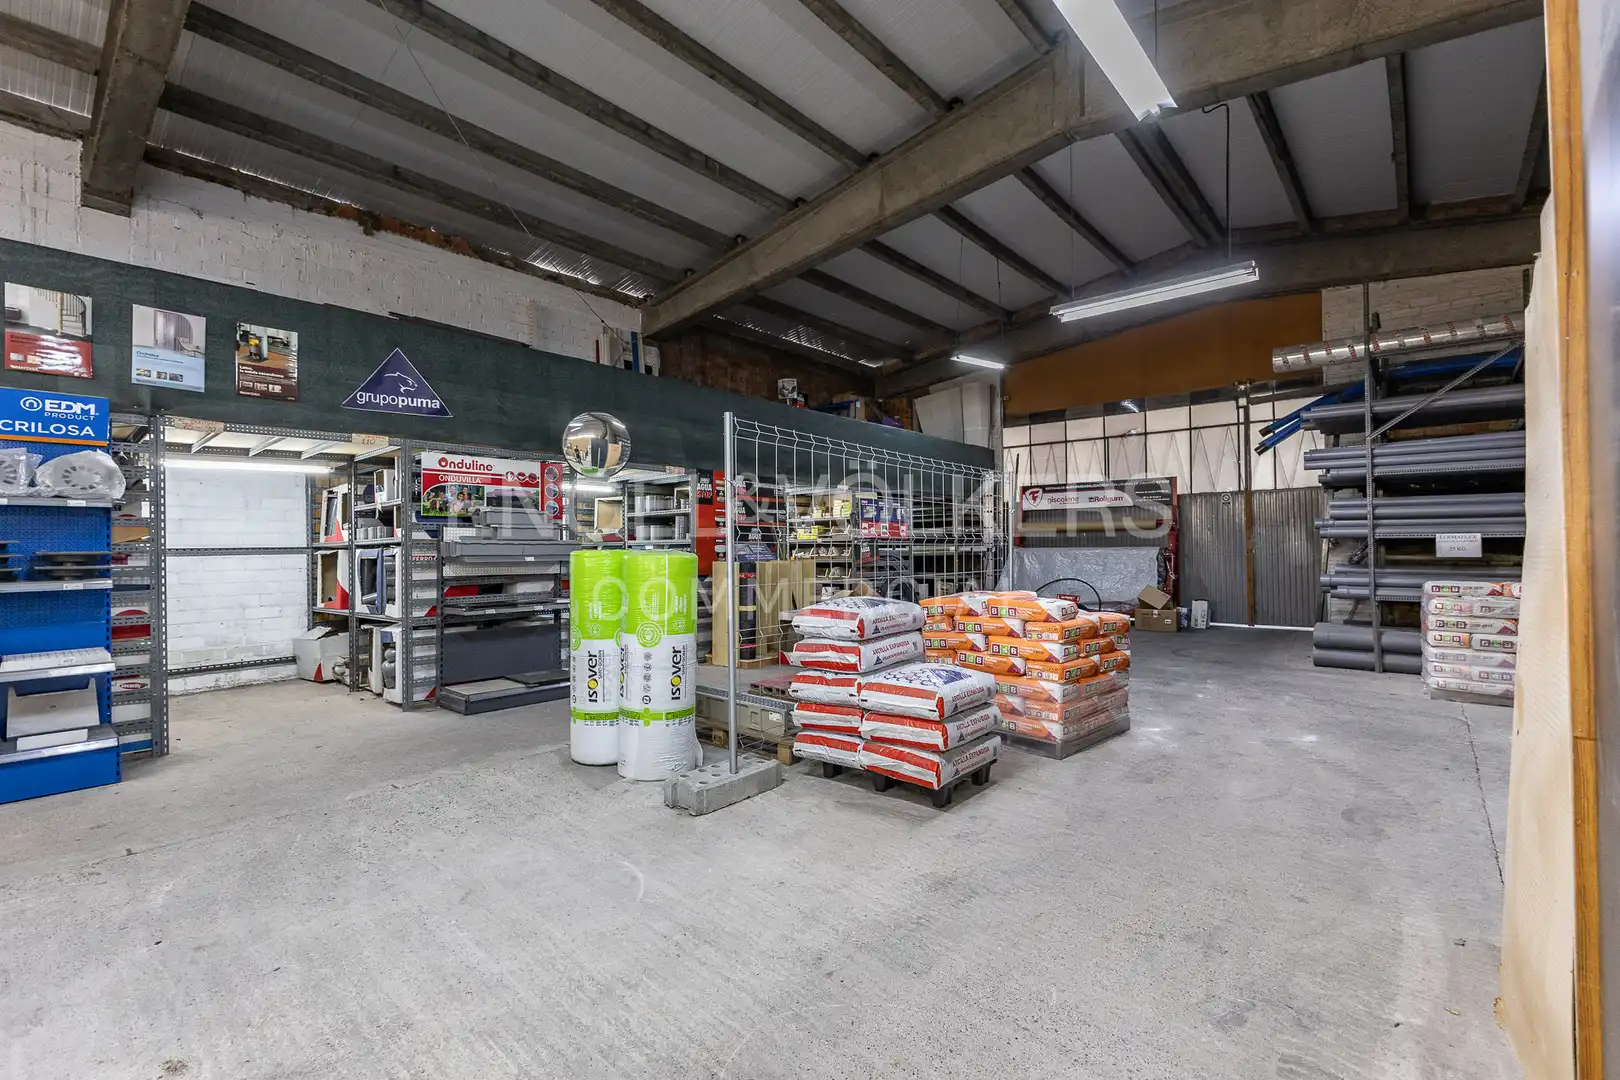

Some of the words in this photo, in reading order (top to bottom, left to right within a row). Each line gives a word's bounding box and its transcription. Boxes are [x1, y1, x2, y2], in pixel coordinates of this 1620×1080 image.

[356, 391, 440, 408] grupopuma
[44, 399, 96, 416] EDM
[44, 412, 94, 420] PRODUCT
[438, 456, 493, 472] Onduline
[438, 474, 481, 484] ONDUVILLA
[696, 490, 712, 498] STOP
[991, 607, 1016, 616] BdB
[958, 622, 982, 632] BdB
[992, 644, 1018, 656] BdB
[960, 653, 983, 665] BdB
